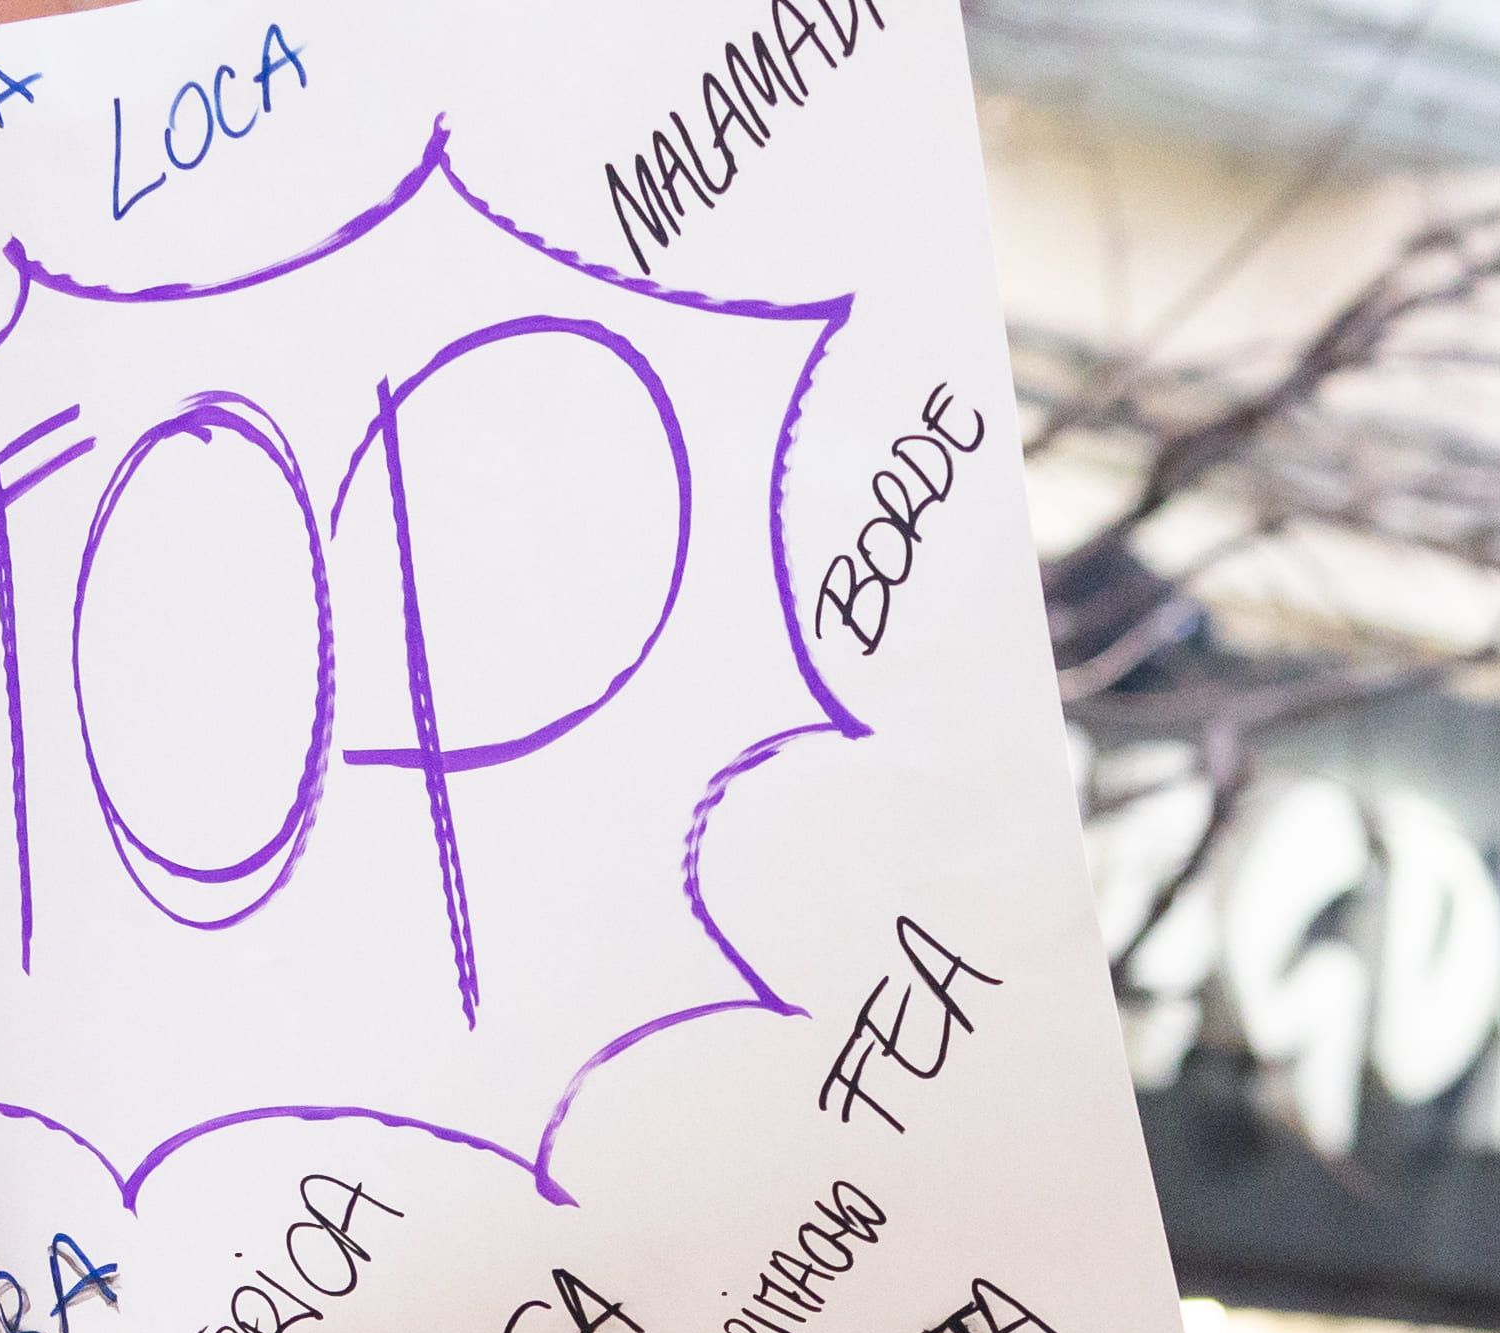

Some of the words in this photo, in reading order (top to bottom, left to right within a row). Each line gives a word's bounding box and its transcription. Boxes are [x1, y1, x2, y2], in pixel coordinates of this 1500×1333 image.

[111, 23, 308, 220] LOCA
[815, 382, 985, 656] BORDE
[818, 915, 1004, 1134] FEA
